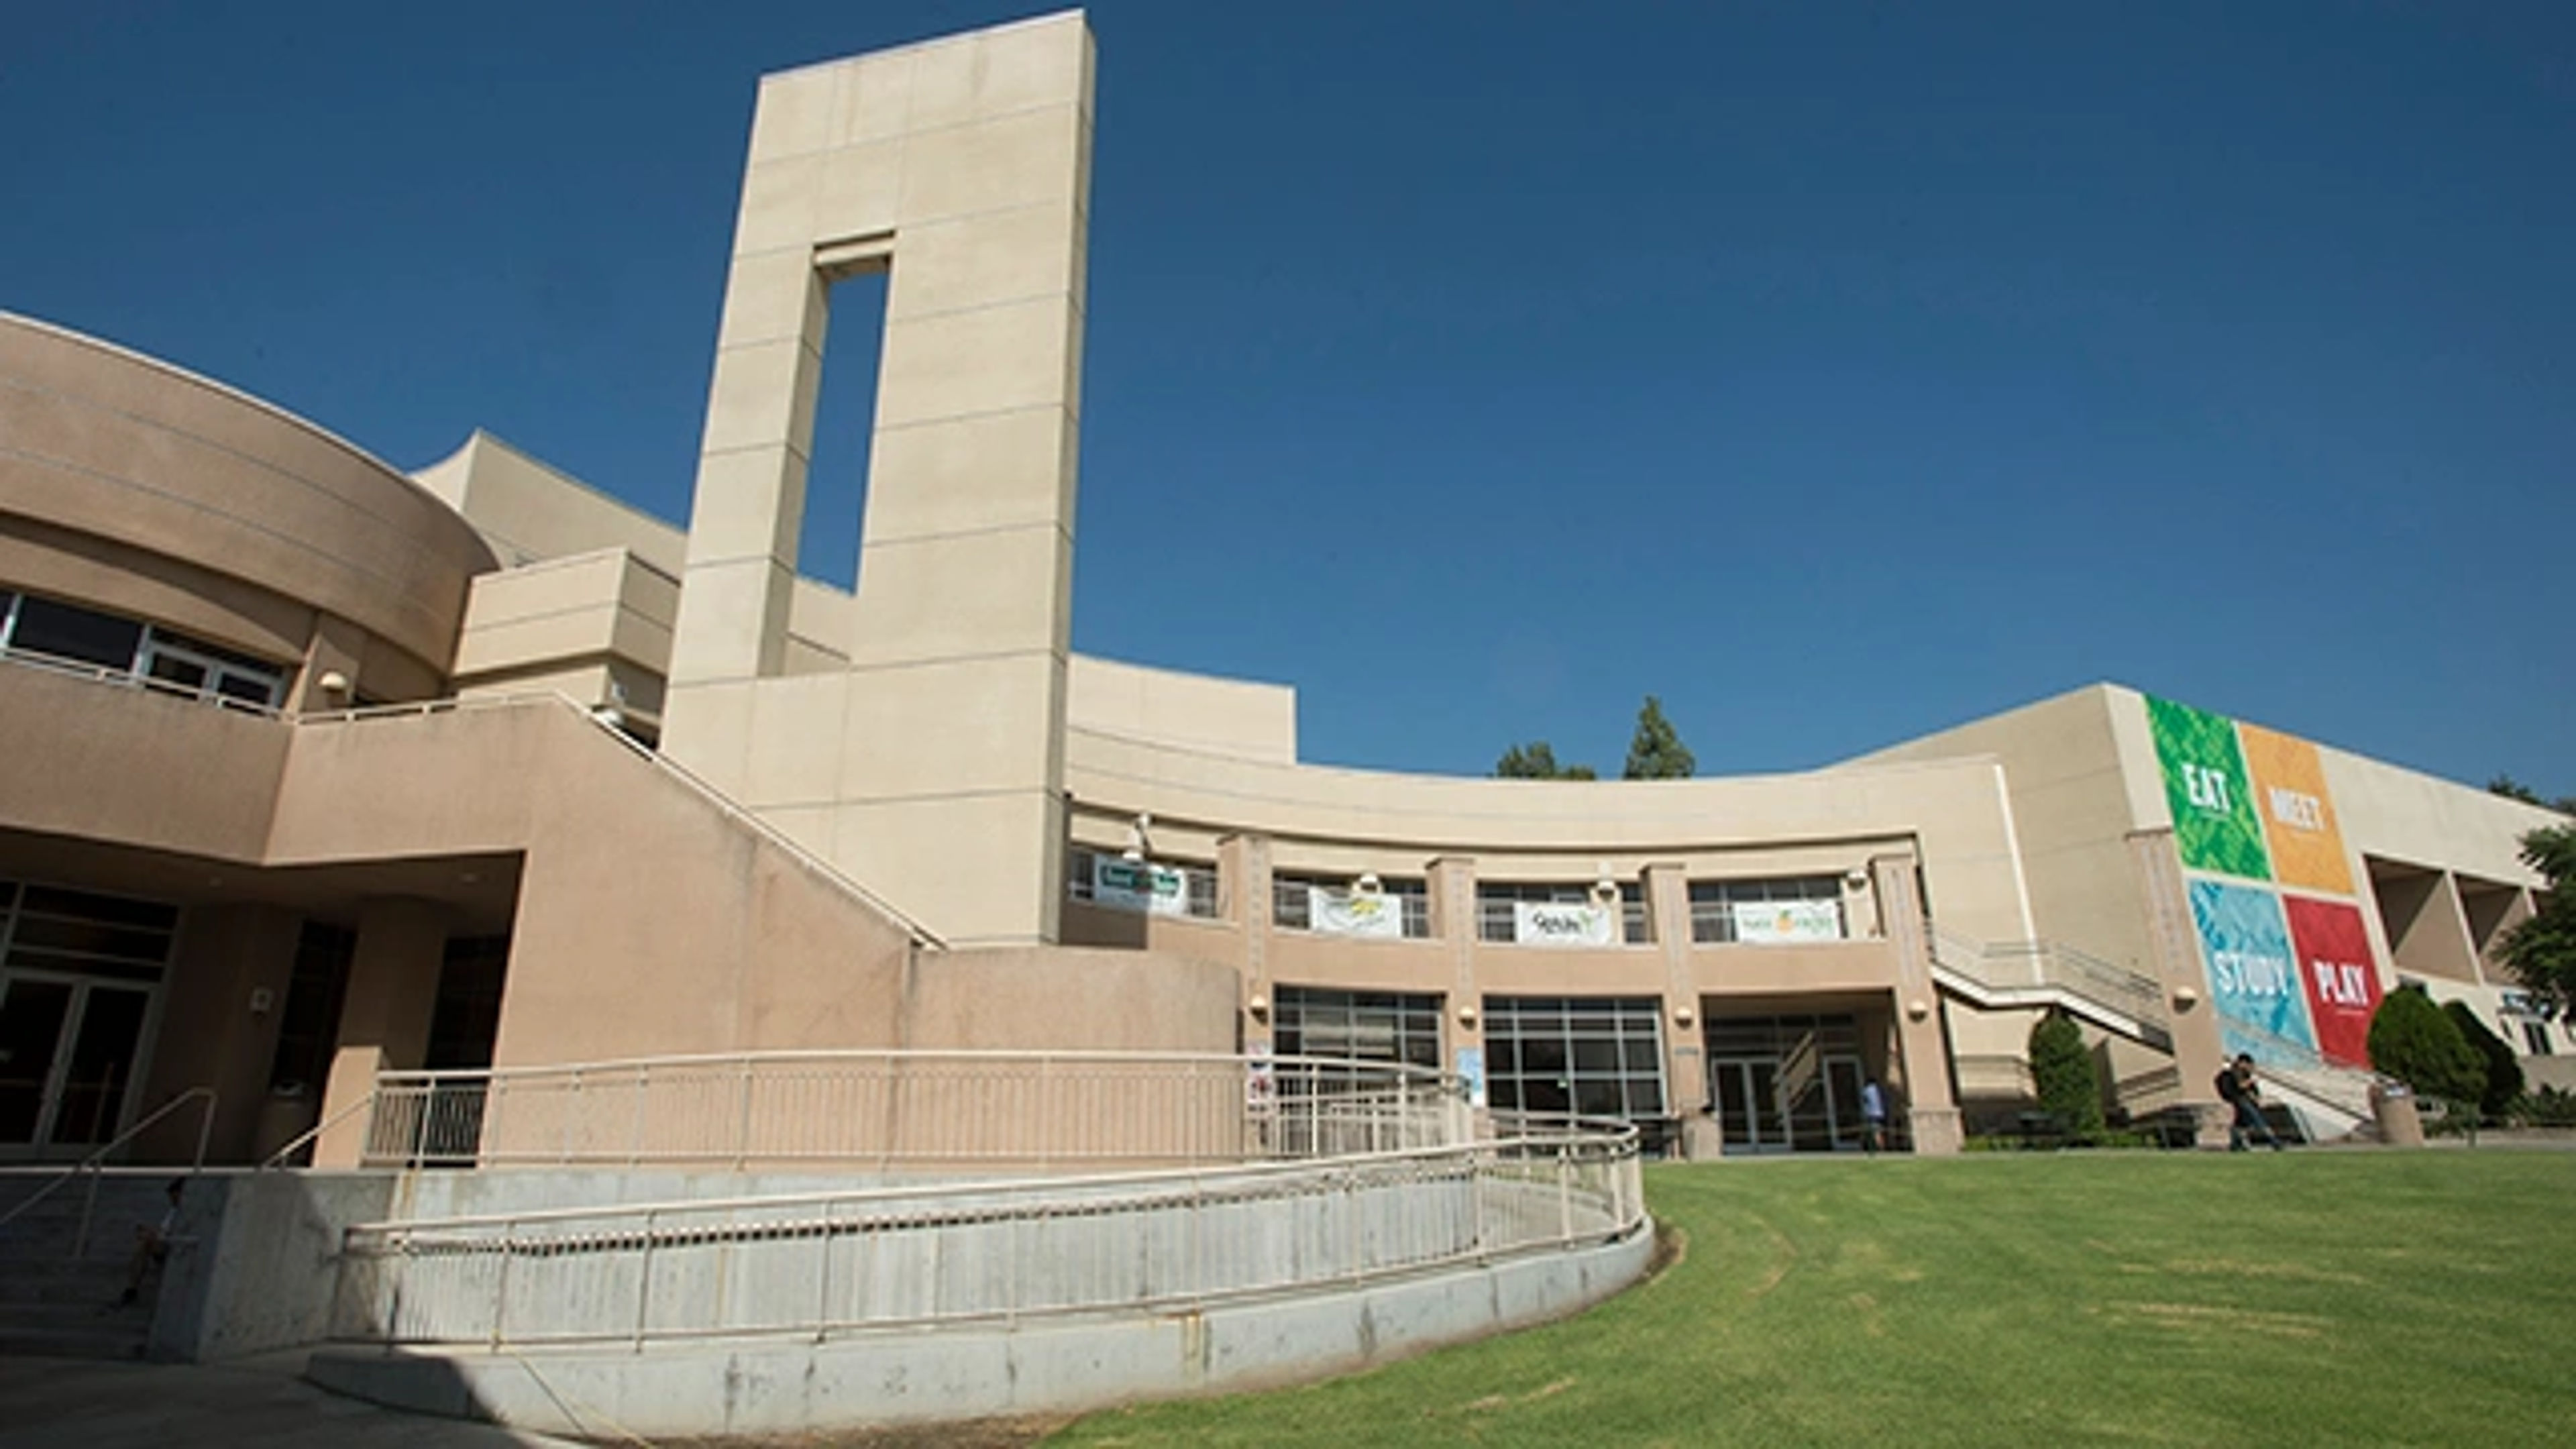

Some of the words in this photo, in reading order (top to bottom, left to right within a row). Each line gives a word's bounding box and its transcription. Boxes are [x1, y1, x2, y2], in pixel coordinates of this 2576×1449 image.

[2182, 763, 2231, 812] EAT
[2214, 951, 2288, 996] STUDY
[2313, 961, 2368, 1005] PLAY
